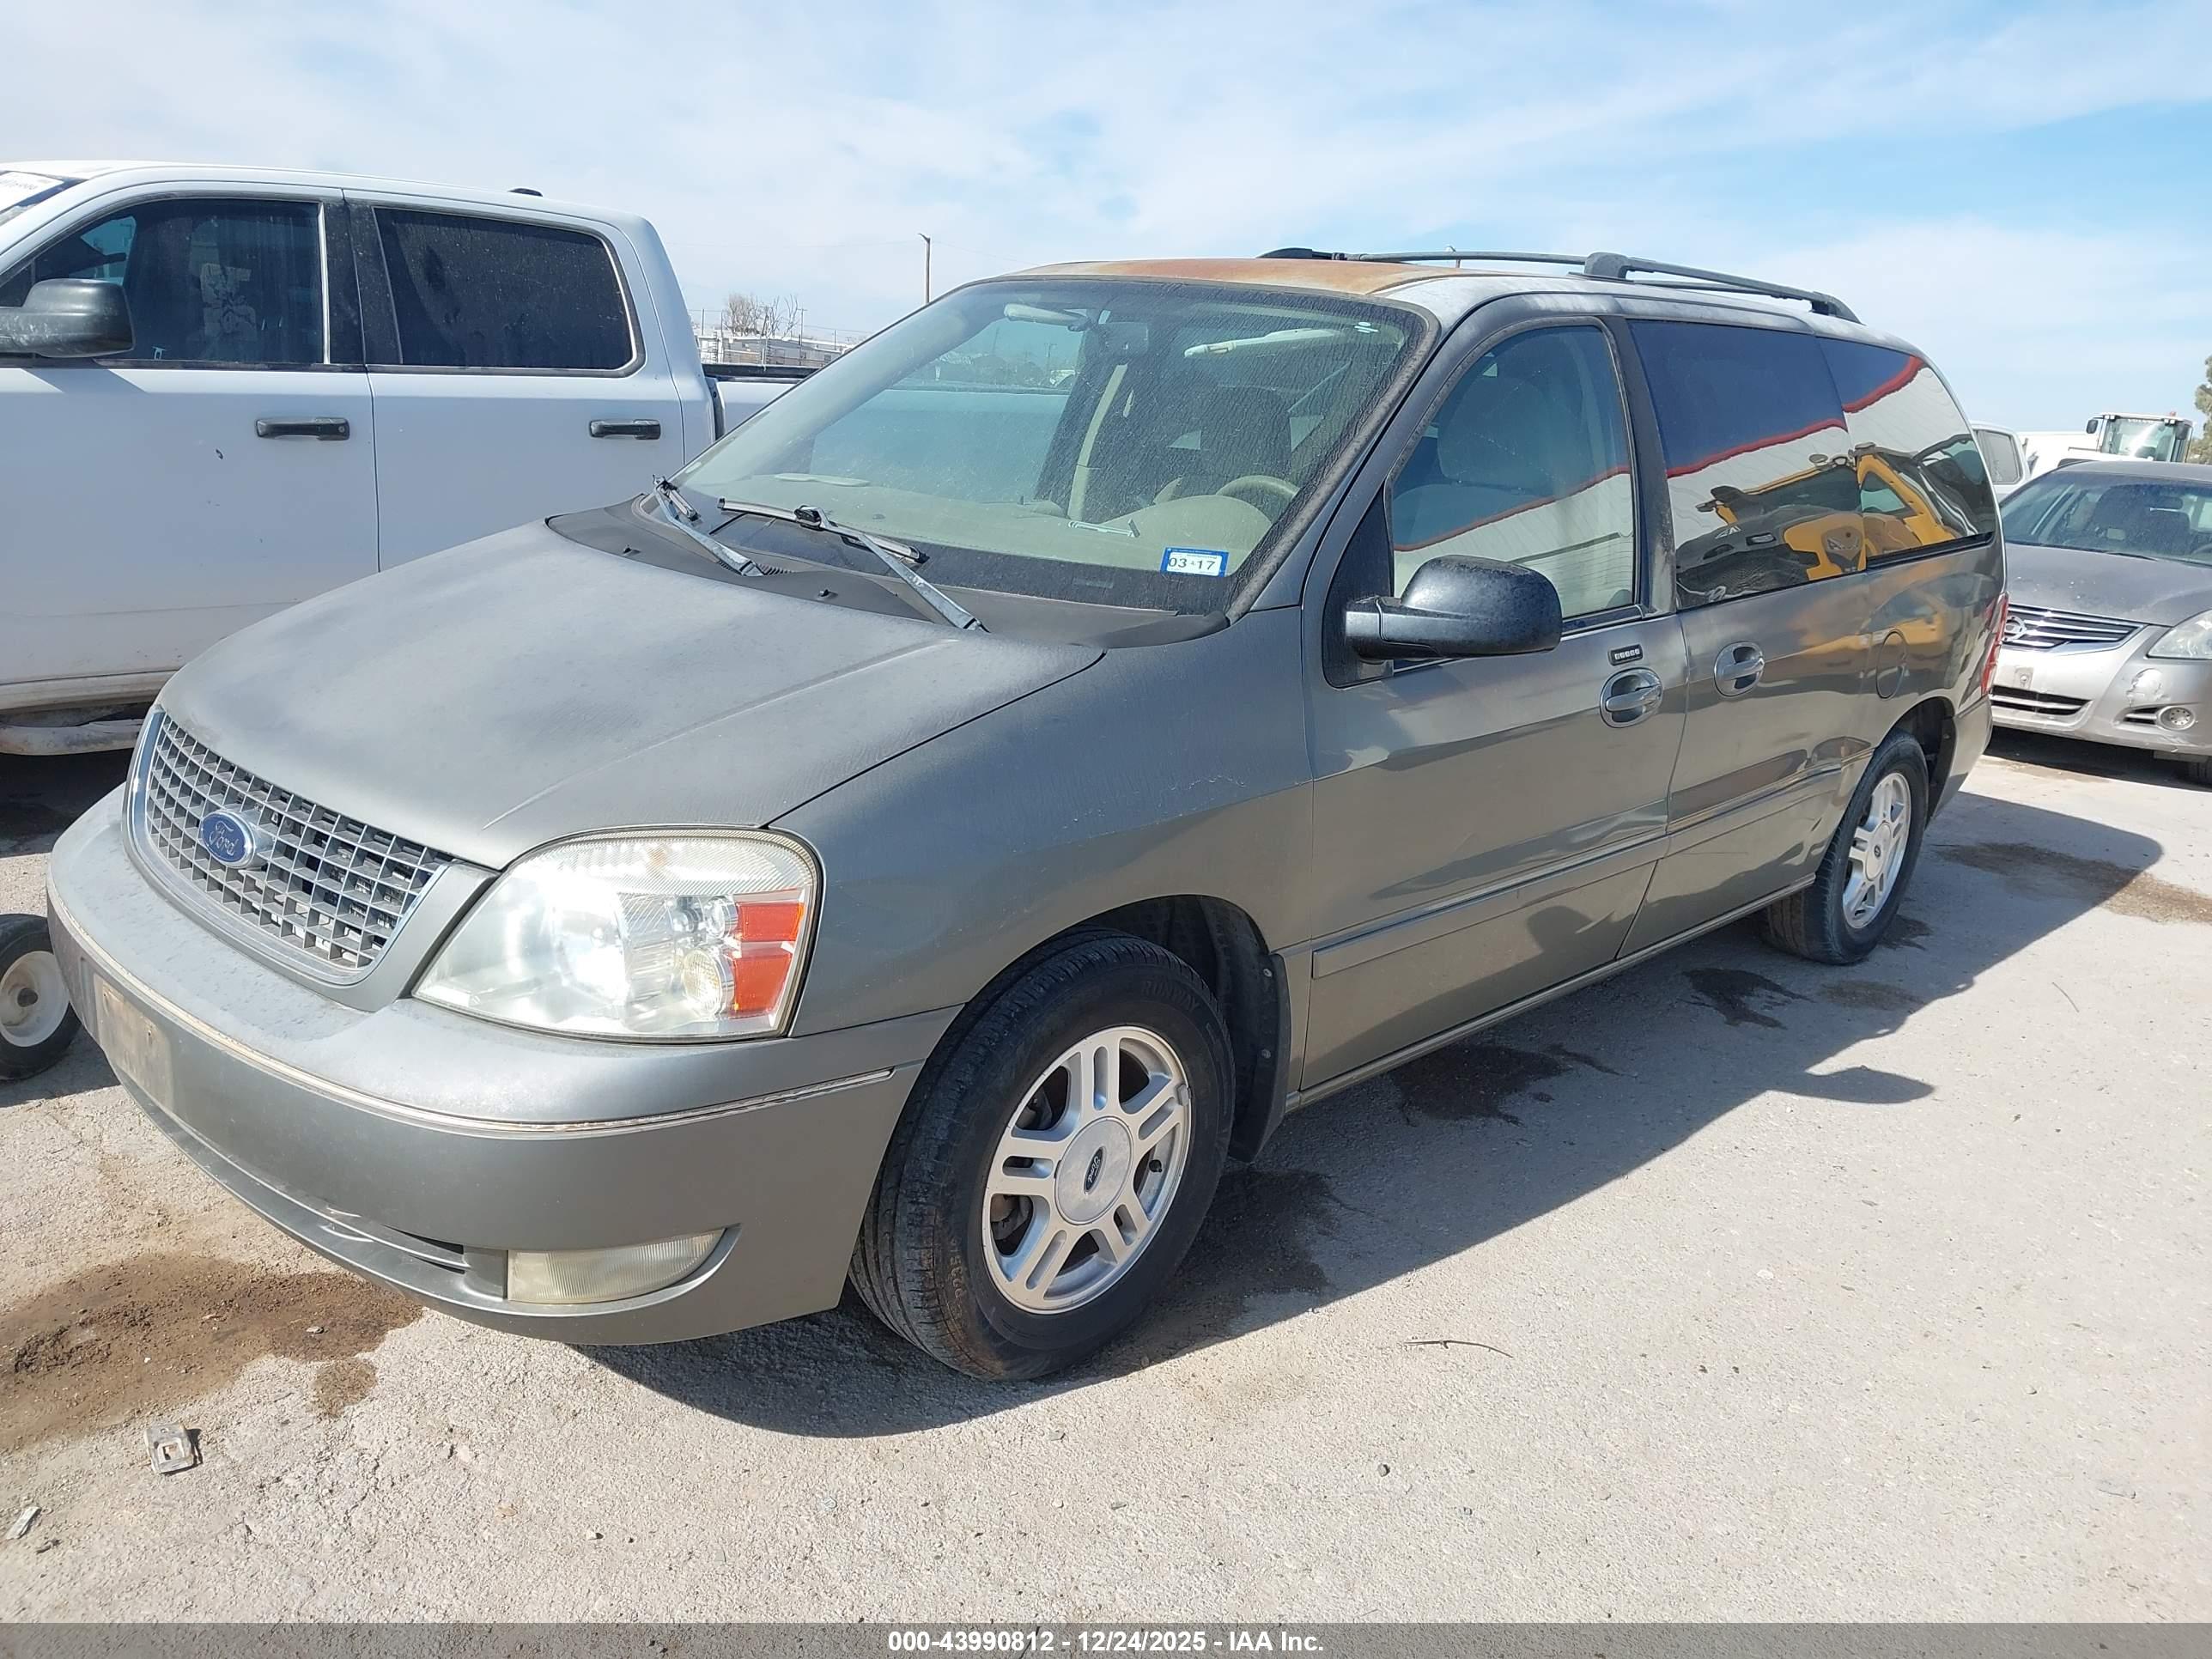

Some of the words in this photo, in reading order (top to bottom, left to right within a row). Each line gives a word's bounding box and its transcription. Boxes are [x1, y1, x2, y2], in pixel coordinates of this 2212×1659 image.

[1168, 557, 1188, 568] 03
[1197, 560, 1216, 570] 17
[210, 820, 240, 856] Ford
[1087, 1155, 1101, 1183] Ford
